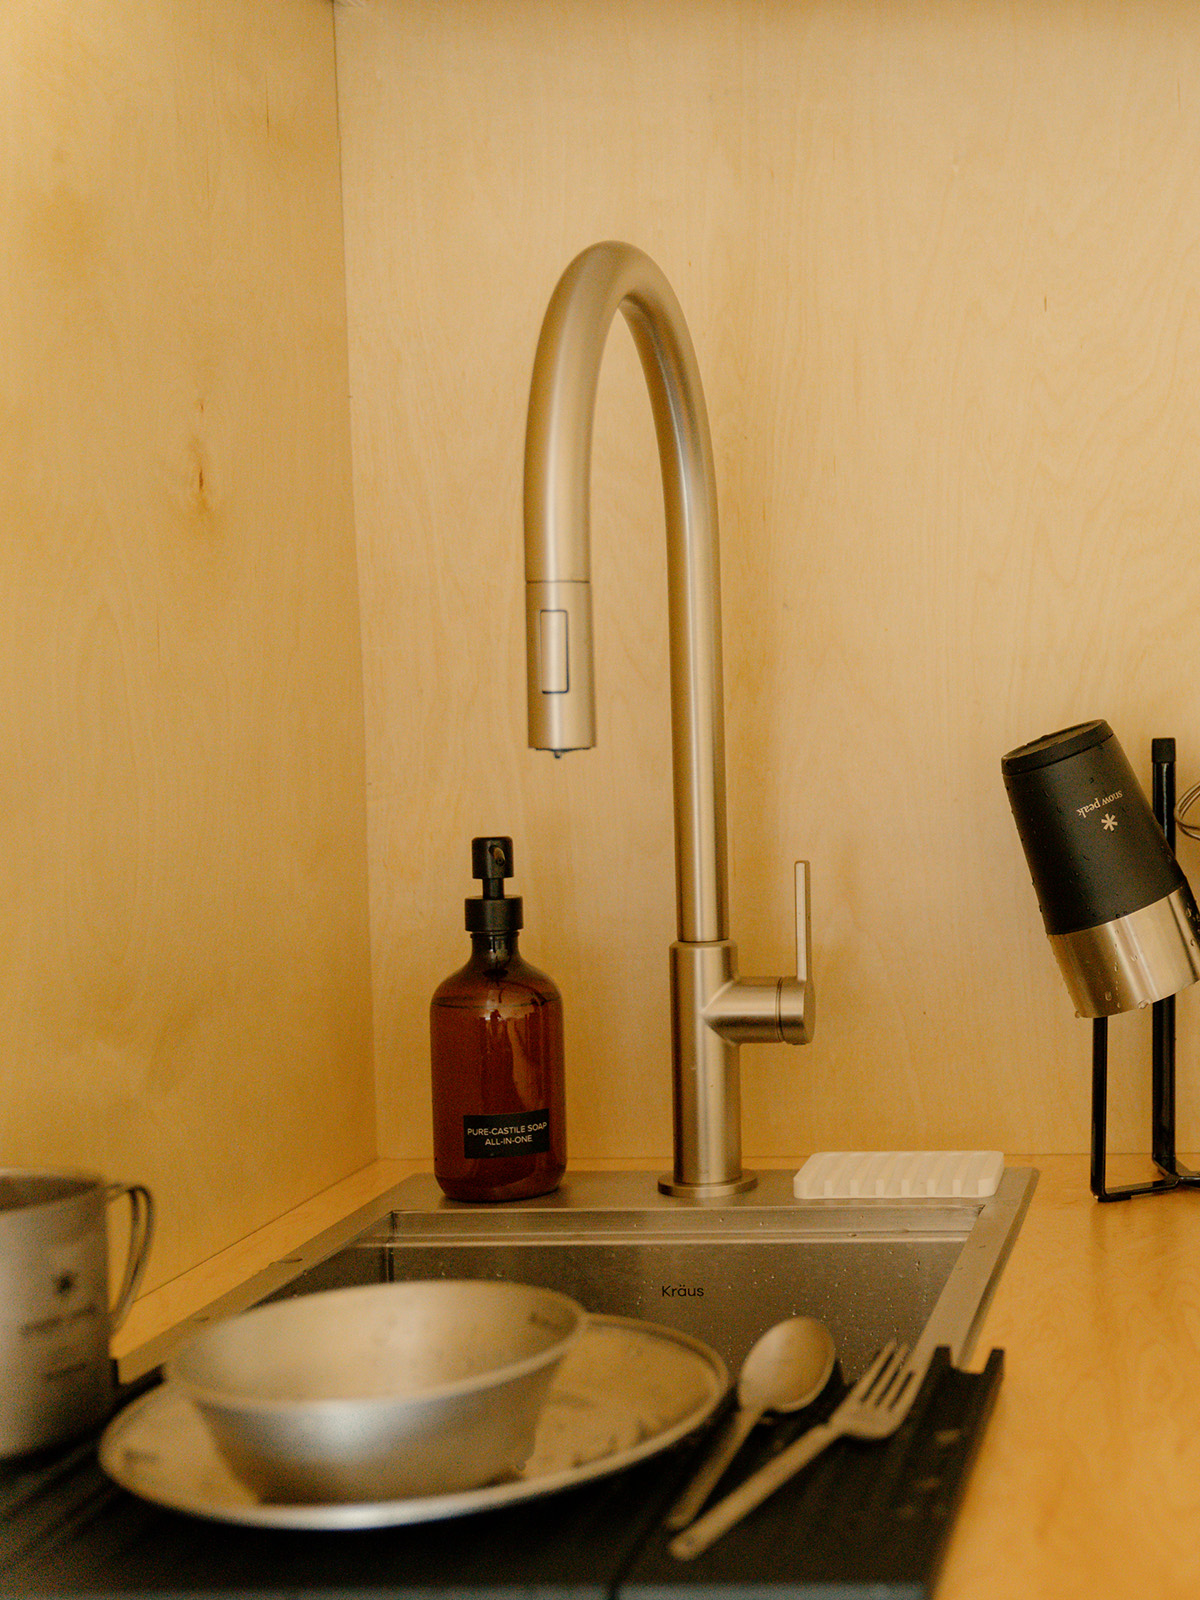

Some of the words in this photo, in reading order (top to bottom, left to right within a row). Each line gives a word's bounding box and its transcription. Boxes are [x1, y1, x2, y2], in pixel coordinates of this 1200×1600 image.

[1102, 790, 1123, 806] snow
[1076, 797, 1101, 818] peak
[467, 1125, 526, 1136] PURE-CASTILE
[527, 1121, 548, 1132] SOAP
[484, 1134, 533, 1146] ALL-IN-ONE
[661, 1284, 705, 1297] Kräus
